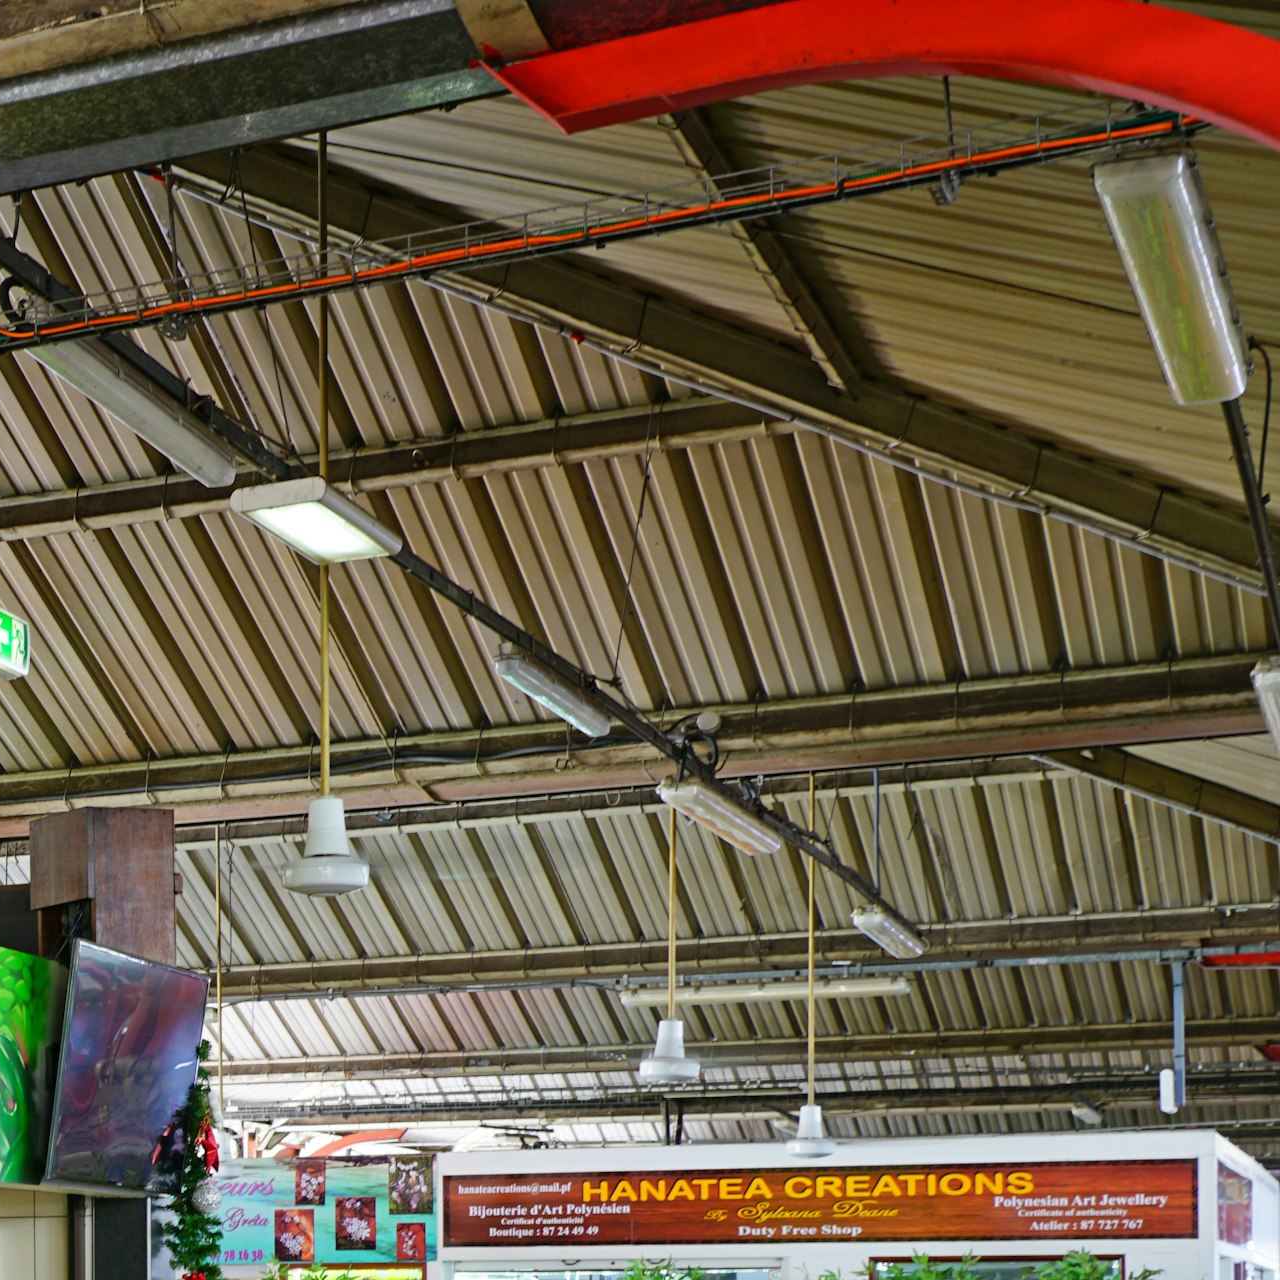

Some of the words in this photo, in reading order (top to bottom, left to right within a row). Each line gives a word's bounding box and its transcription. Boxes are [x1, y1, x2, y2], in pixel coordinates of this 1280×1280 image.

[458, 1181, 572, 1196] hanateacreations@mail.pf
[583, 1176, 773, 1203] HANATEA
[784, 1172, 1034, 1199] CREATIONS
[994, 1195, 1069, 1209] Polynesian
[1071, 1194, 1096, 1207] Art
[1099, 1193, 1168, 1208] Jewellery
[469, 1204, 529, 1219] Bijouterie
[530, 1203, 564, 1216] d'Art
[566, 1202, 631, 1217] Polynésien
[1018, 1209, 1063, 1217] Certificate
[1065, 1208, 1074, 1217] of
[1076, 1208, 1128, 1217] authenticity
[501, 1217, 534, 1226] Certificat
[1029, 1219, 1070, 1231] Atelier
[1080, 1219, 1094, 1230] 87
[1097, 1219, 1119, 1230] 727
[1122, 1218, 1143, 1229] 767
[489, 1227, 534, 1239] Boutique
[543, 1227, 554, 1236] 87
[556, 1227, 569, 1236] 24
[571, 1226, 584, 1236] 49
[586, 1226, 599, 1235] 49
[738, 1224, 777, 1237] Duty
[782, 1224, 817, 1236] Free
[820, 1223, 862, 1236] Shop
[224, 1250, 235, 1262] 78
[251, 1249, 263, 1262] 38
